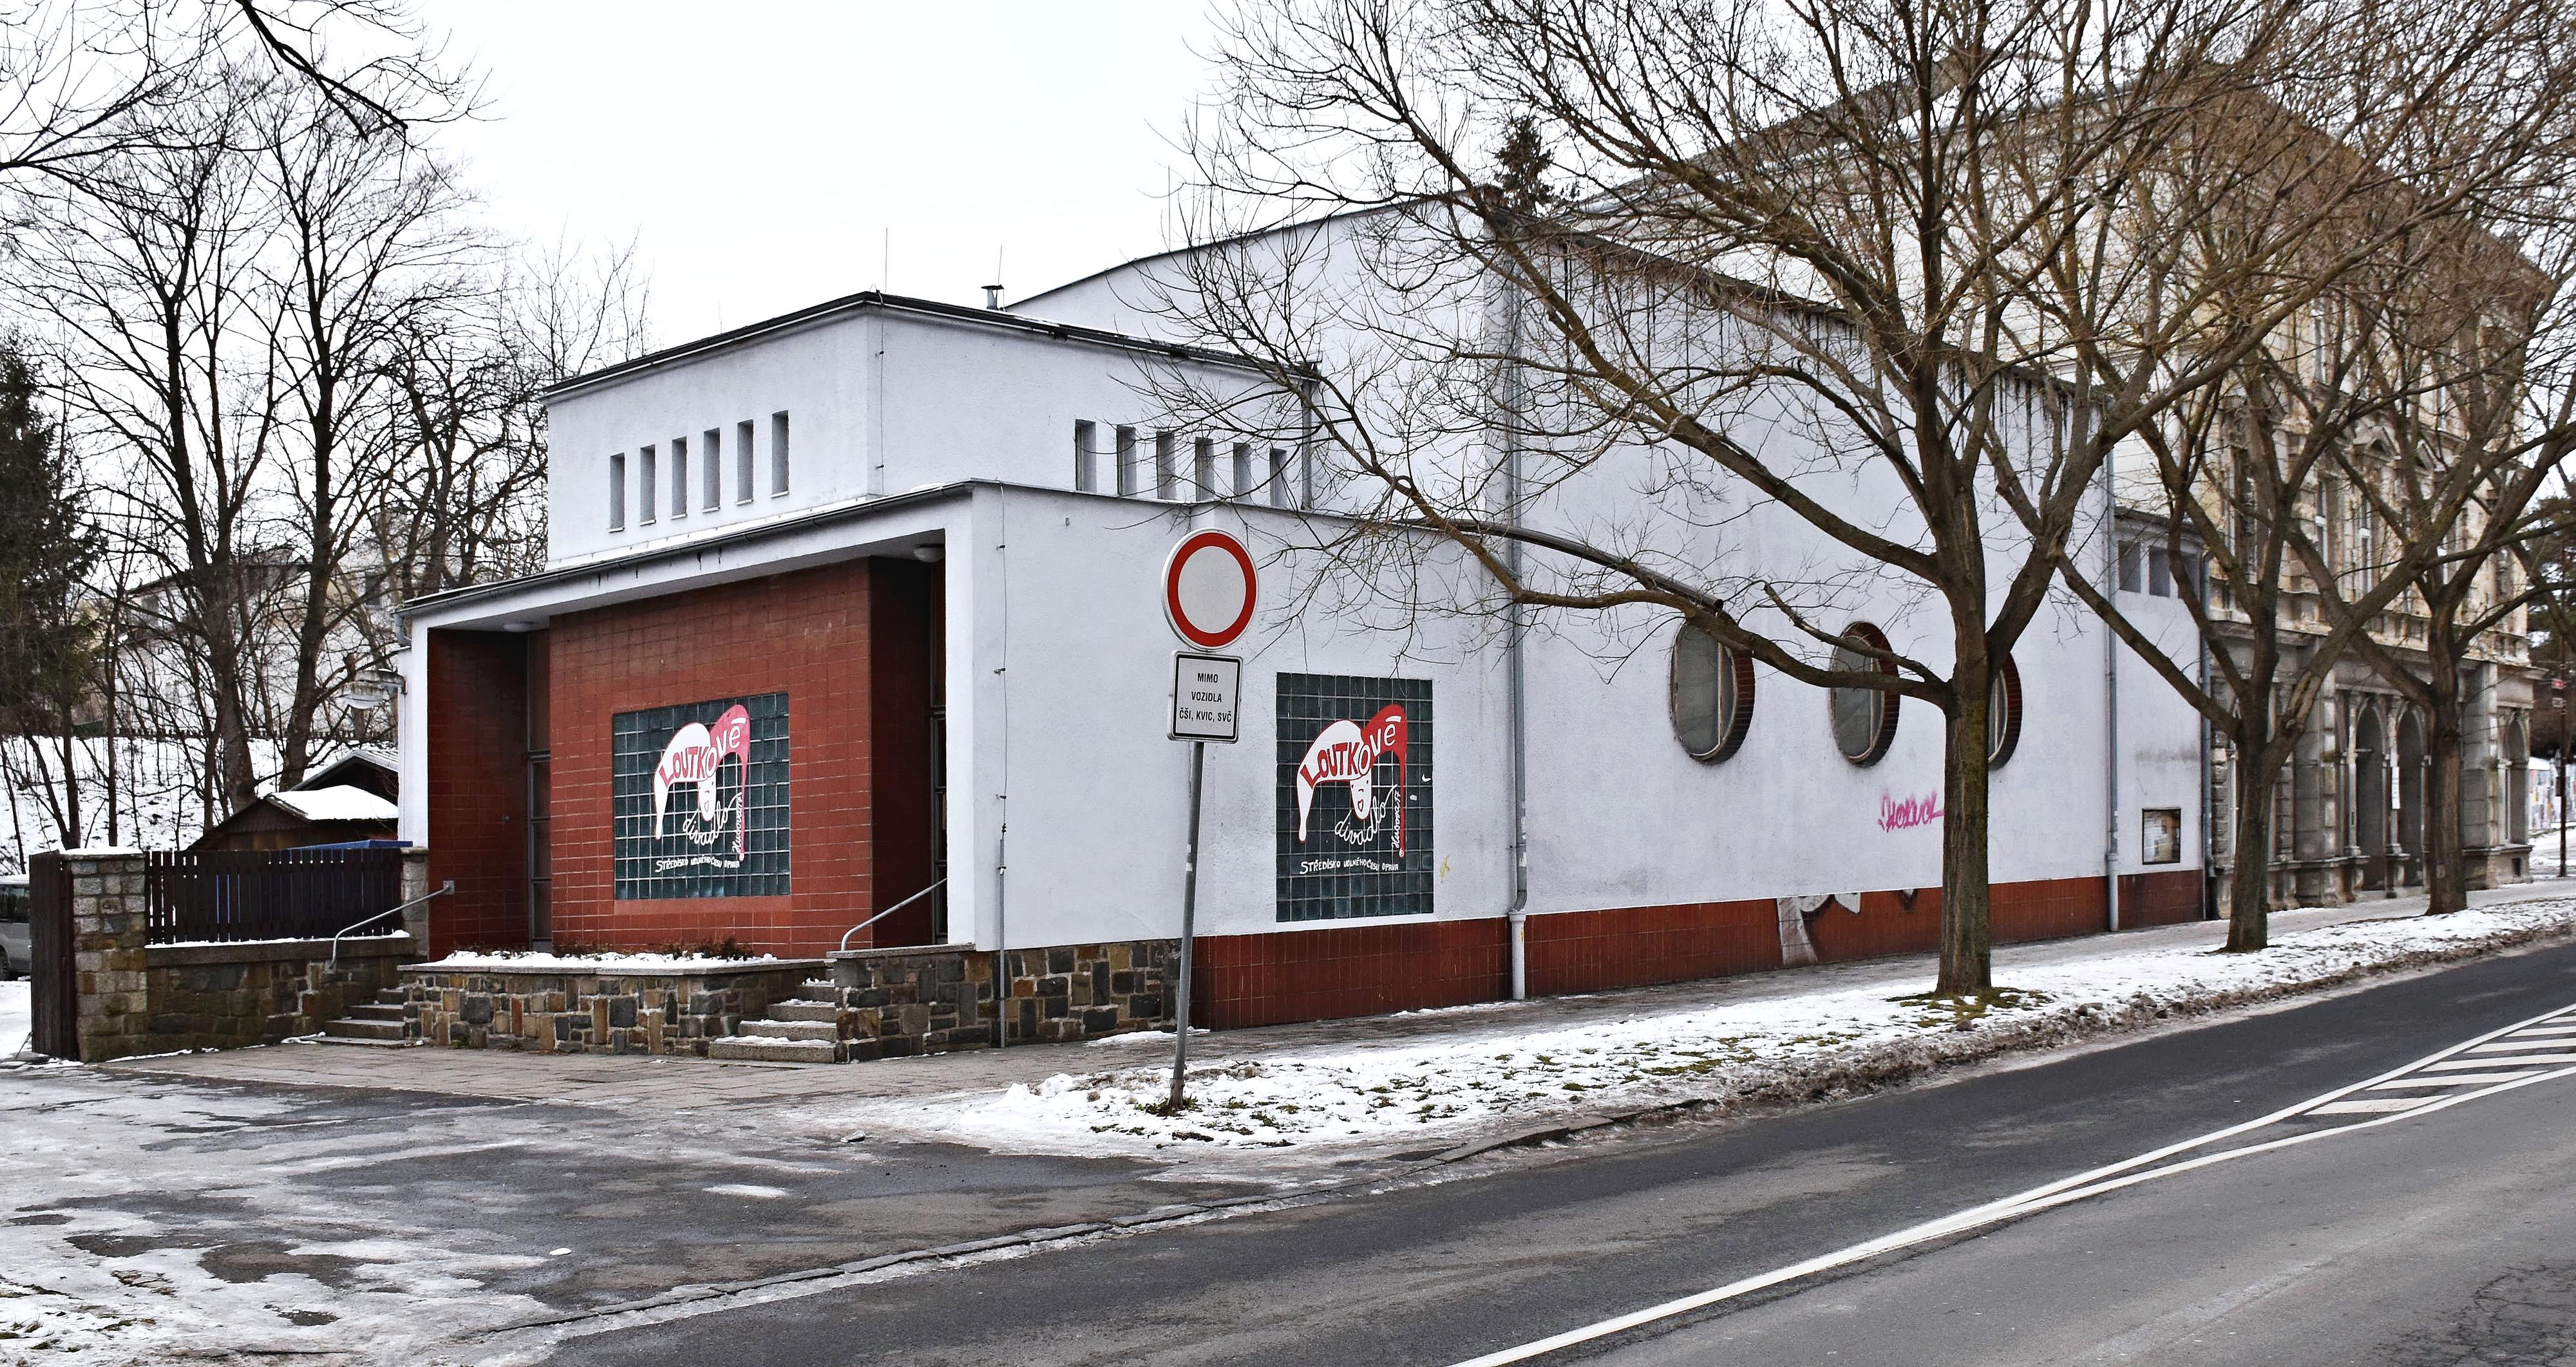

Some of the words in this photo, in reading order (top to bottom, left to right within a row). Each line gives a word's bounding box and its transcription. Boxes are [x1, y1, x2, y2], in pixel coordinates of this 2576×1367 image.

[1197, 673, 1218, 683] MIMO
[1191, 692, 1222, 702] VOZIDLA
[1179, 707, 1193, 721] ČŠI,
[1196, 710, 1215, 722] KVIC,
[1217, 711, 1231, 722] SVČ
[683, 791, 743, 846] divadlo
[1334, 784, 1398, 845] divadlo
[1391, 802, 1401, 849] Husova
[1382, 862, 1399, 871] OPAVA
